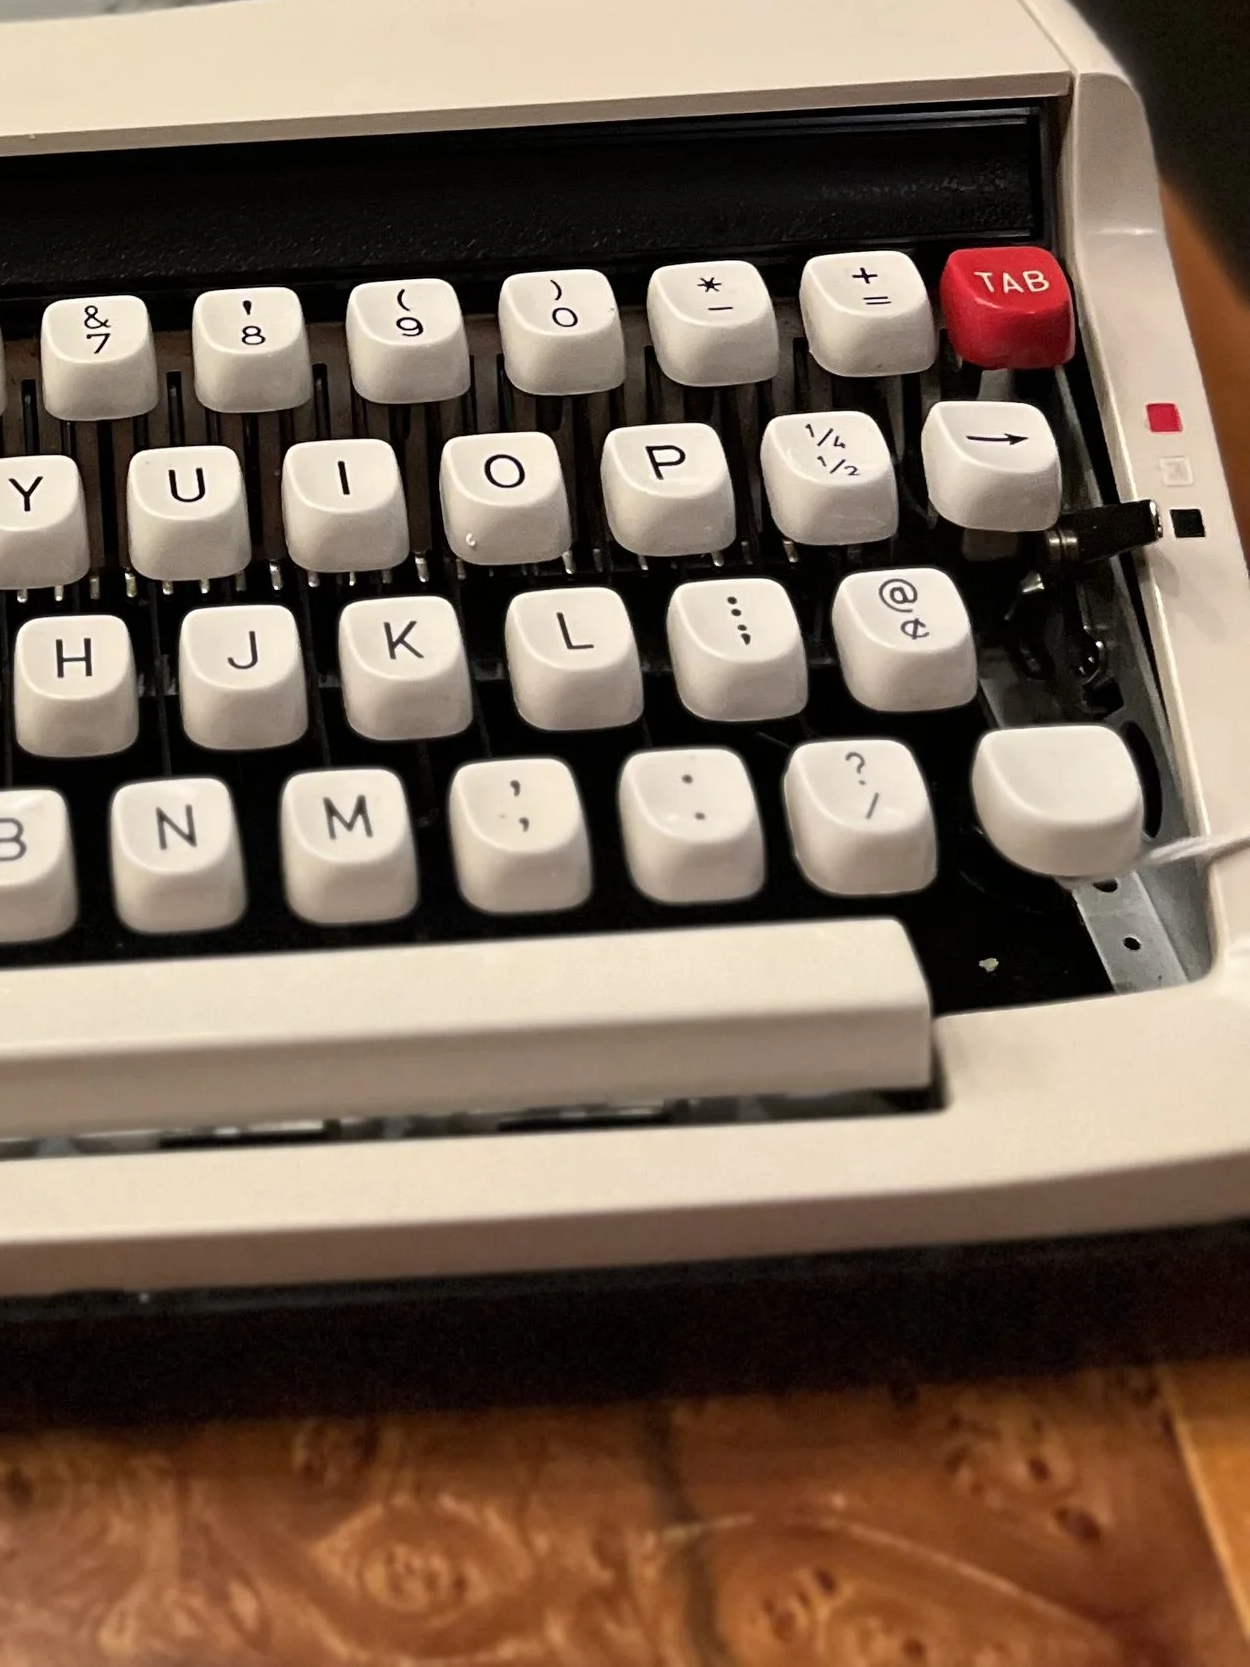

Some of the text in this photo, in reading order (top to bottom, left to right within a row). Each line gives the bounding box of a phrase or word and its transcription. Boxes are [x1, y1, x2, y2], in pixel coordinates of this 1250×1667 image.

[550, 279, 563, 301] )
[852, 267, 878, 284] +
[975, 270, 1049, 293] TAB
[84, 305, 110, 330] &
[396, 288, 411, 312] (
[863, 296, 892, 306] =
[86, 332, 111, 354] 7
[241, 325, 266, 346] 8
[395, 316, 424, 337] 9
[337, 460, 350, 496] I
[484, 454, 526, 489] O
[645, 444, 686, 480] P
[8, 476, 44, 512] Y
[168, 467, 206, 503] U
[878, 578, 918, 613] @
[383, 620, 424, 660] K
[556, 612, 594, 650] L
[55, 637, 93, 679] H
[227, 630, 258, 670] J
[845, 751, 865, 785] ?
[156, 805, 197, 850] N
[323, 795, 373, 839] M
